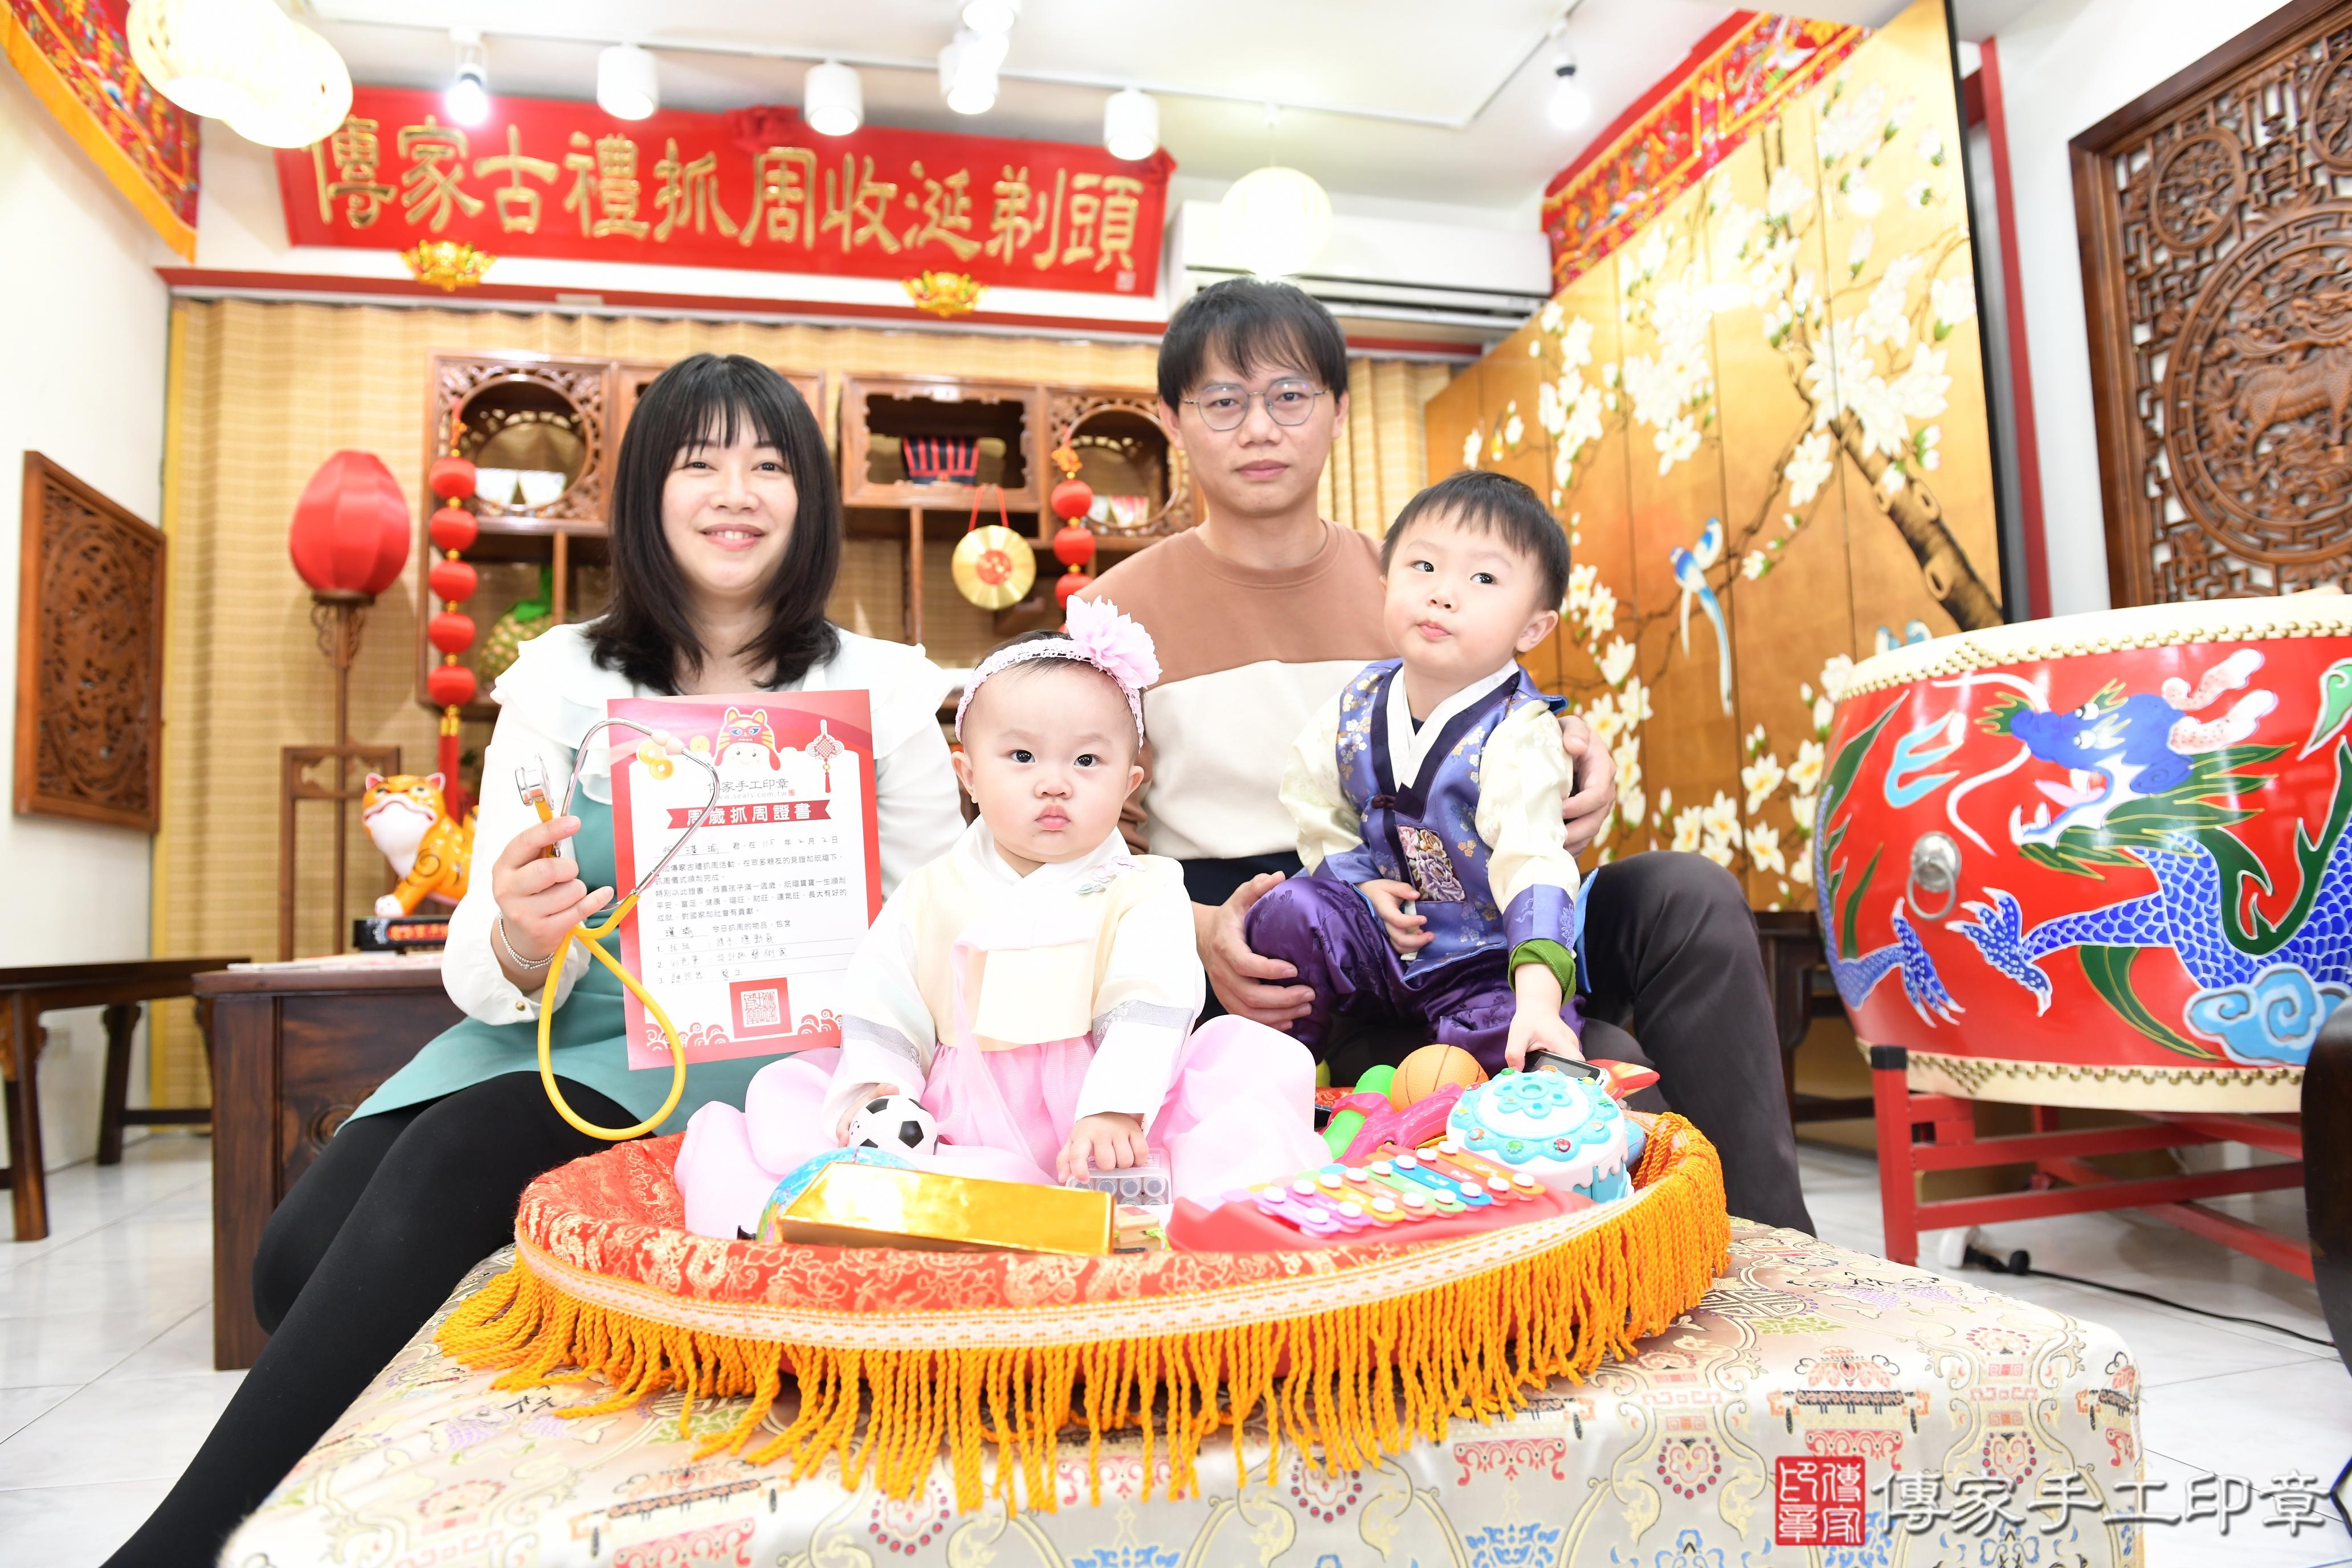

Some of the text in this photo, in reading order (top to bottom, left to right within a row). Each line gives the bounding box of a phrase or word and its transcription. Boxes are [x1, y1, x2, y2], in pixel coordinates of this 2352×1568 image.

[304, 114, 1144, 272] 傳家古禮抓周收涎剃頭
[687, 803, 811, 826] 周歲抓周證書
